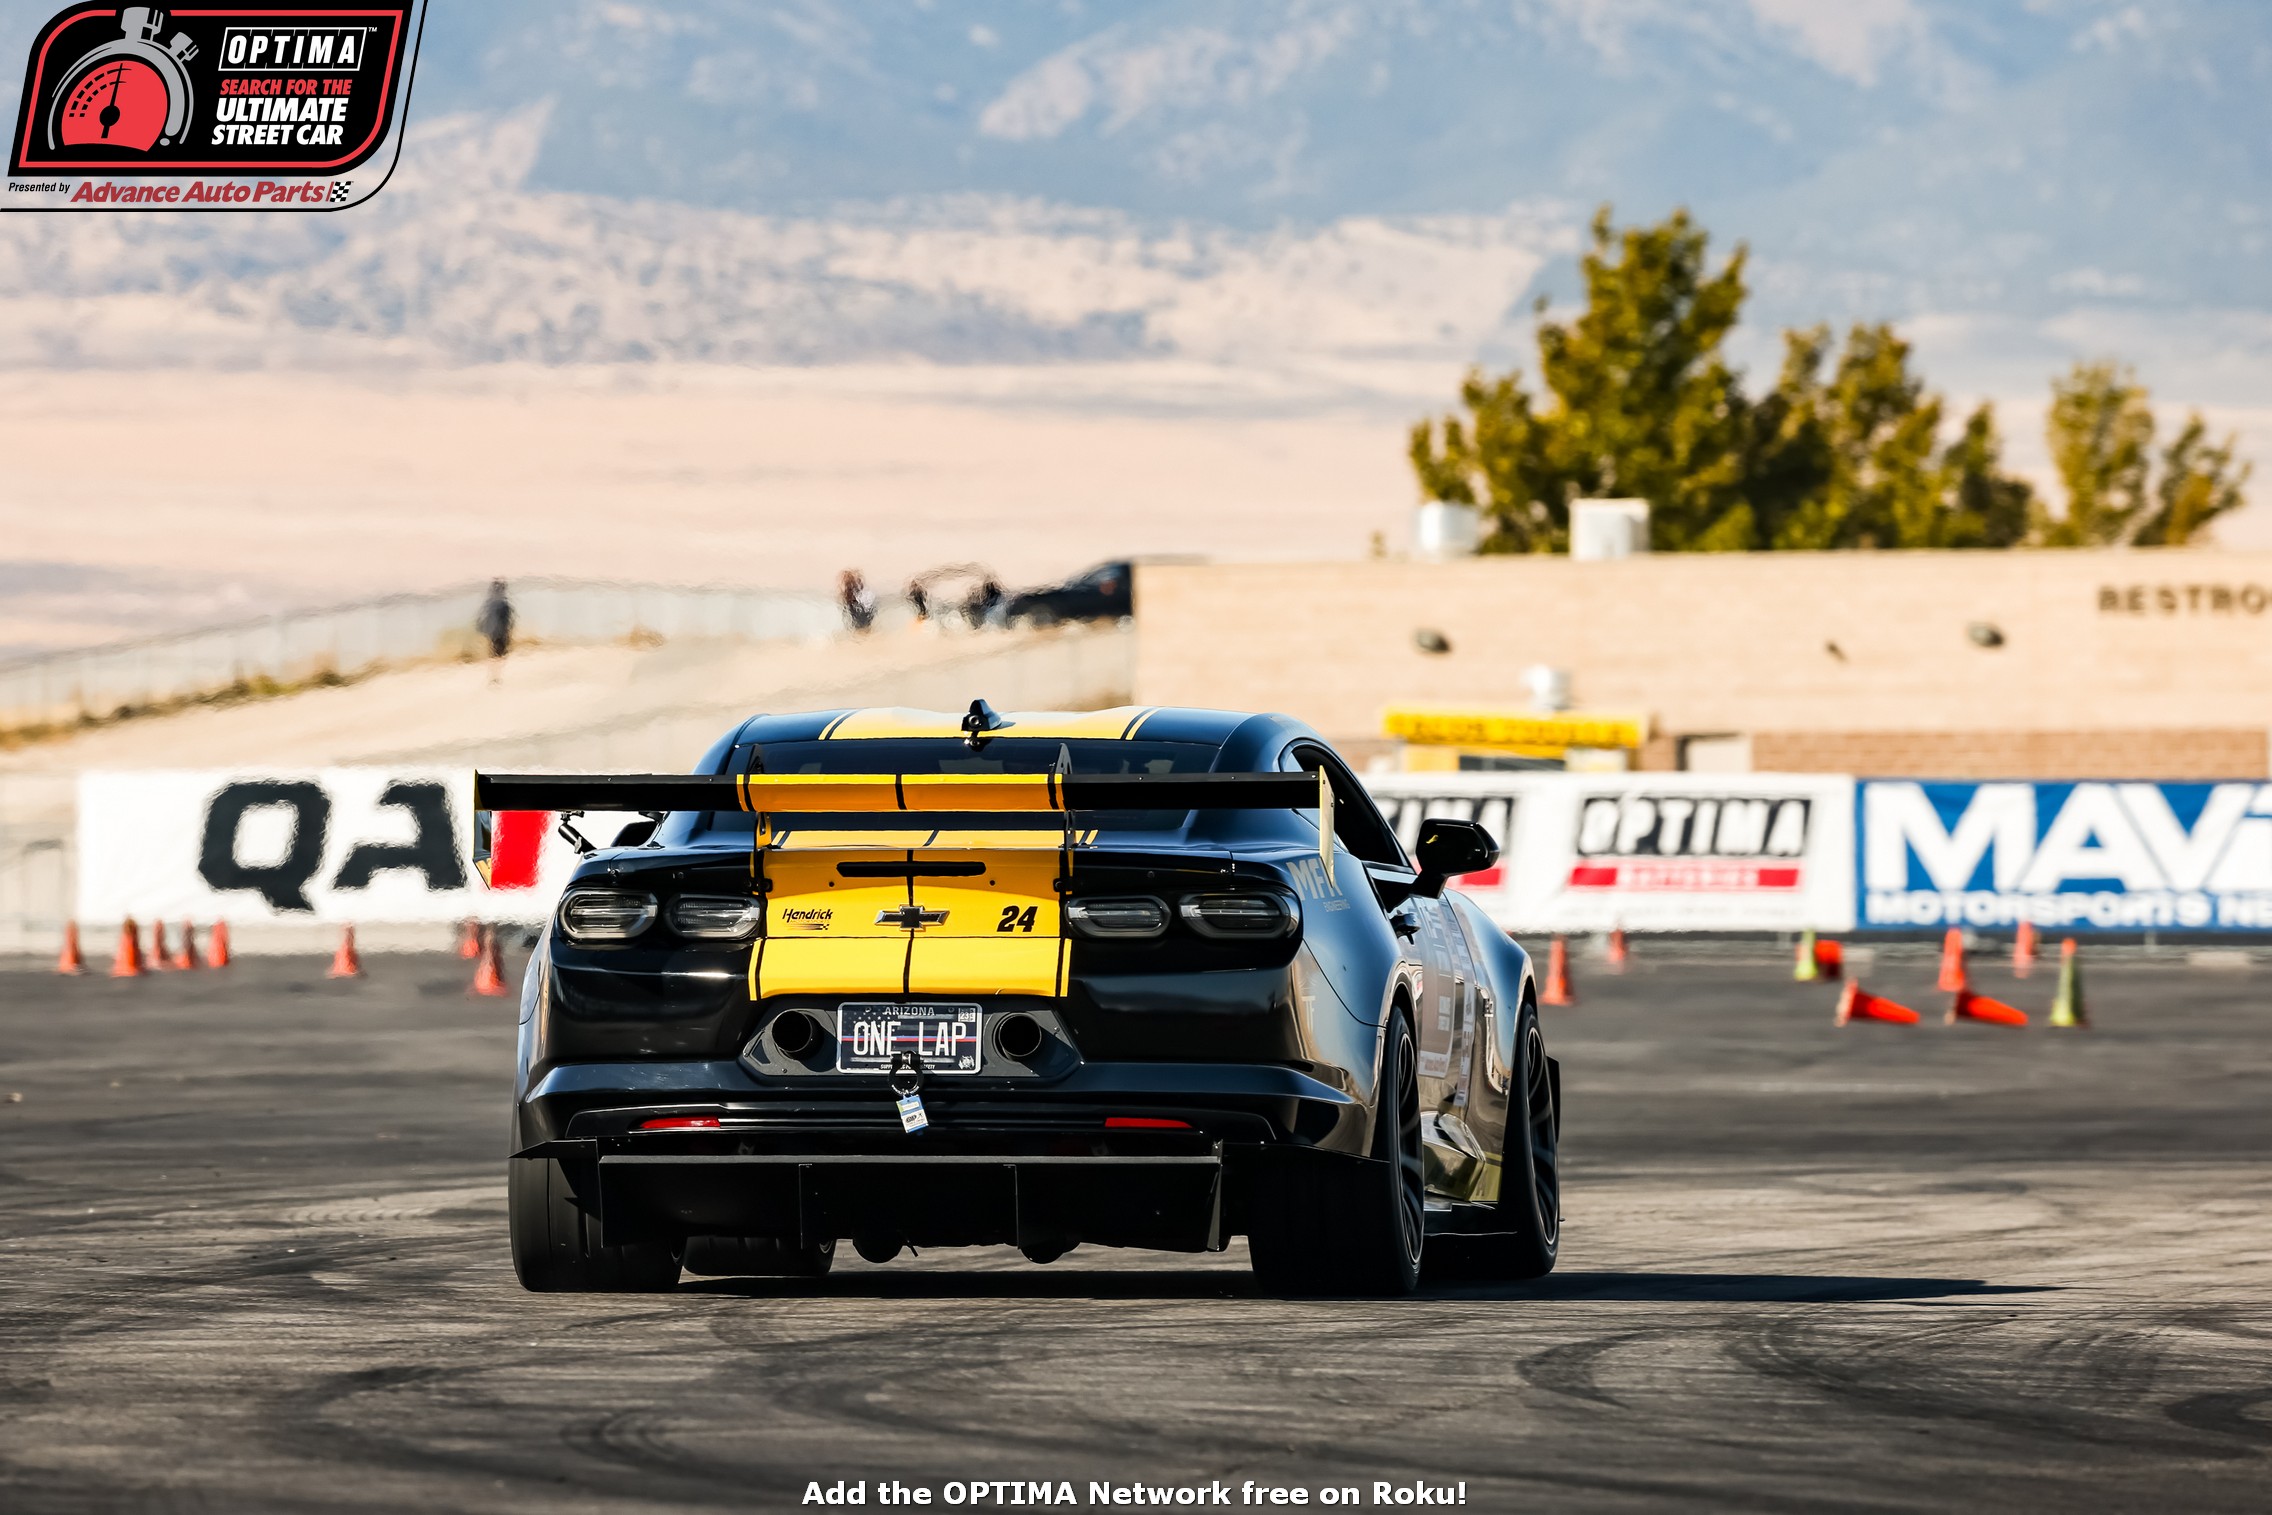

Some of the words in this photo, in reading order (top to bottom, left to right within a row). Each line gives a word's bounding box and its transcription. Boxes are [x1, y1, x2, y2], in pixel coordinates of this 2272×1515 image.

[1579, 797, 1807, 857] OPTIMA
[782, 908, 833, 923] Hendrick
[996, 905, 1039, 933] 24
[883, 1006, 936, 1017] ARIZONA
[853, 1021, 902, 1056] ONE
[918, 1021, 967, 1057] LAP
